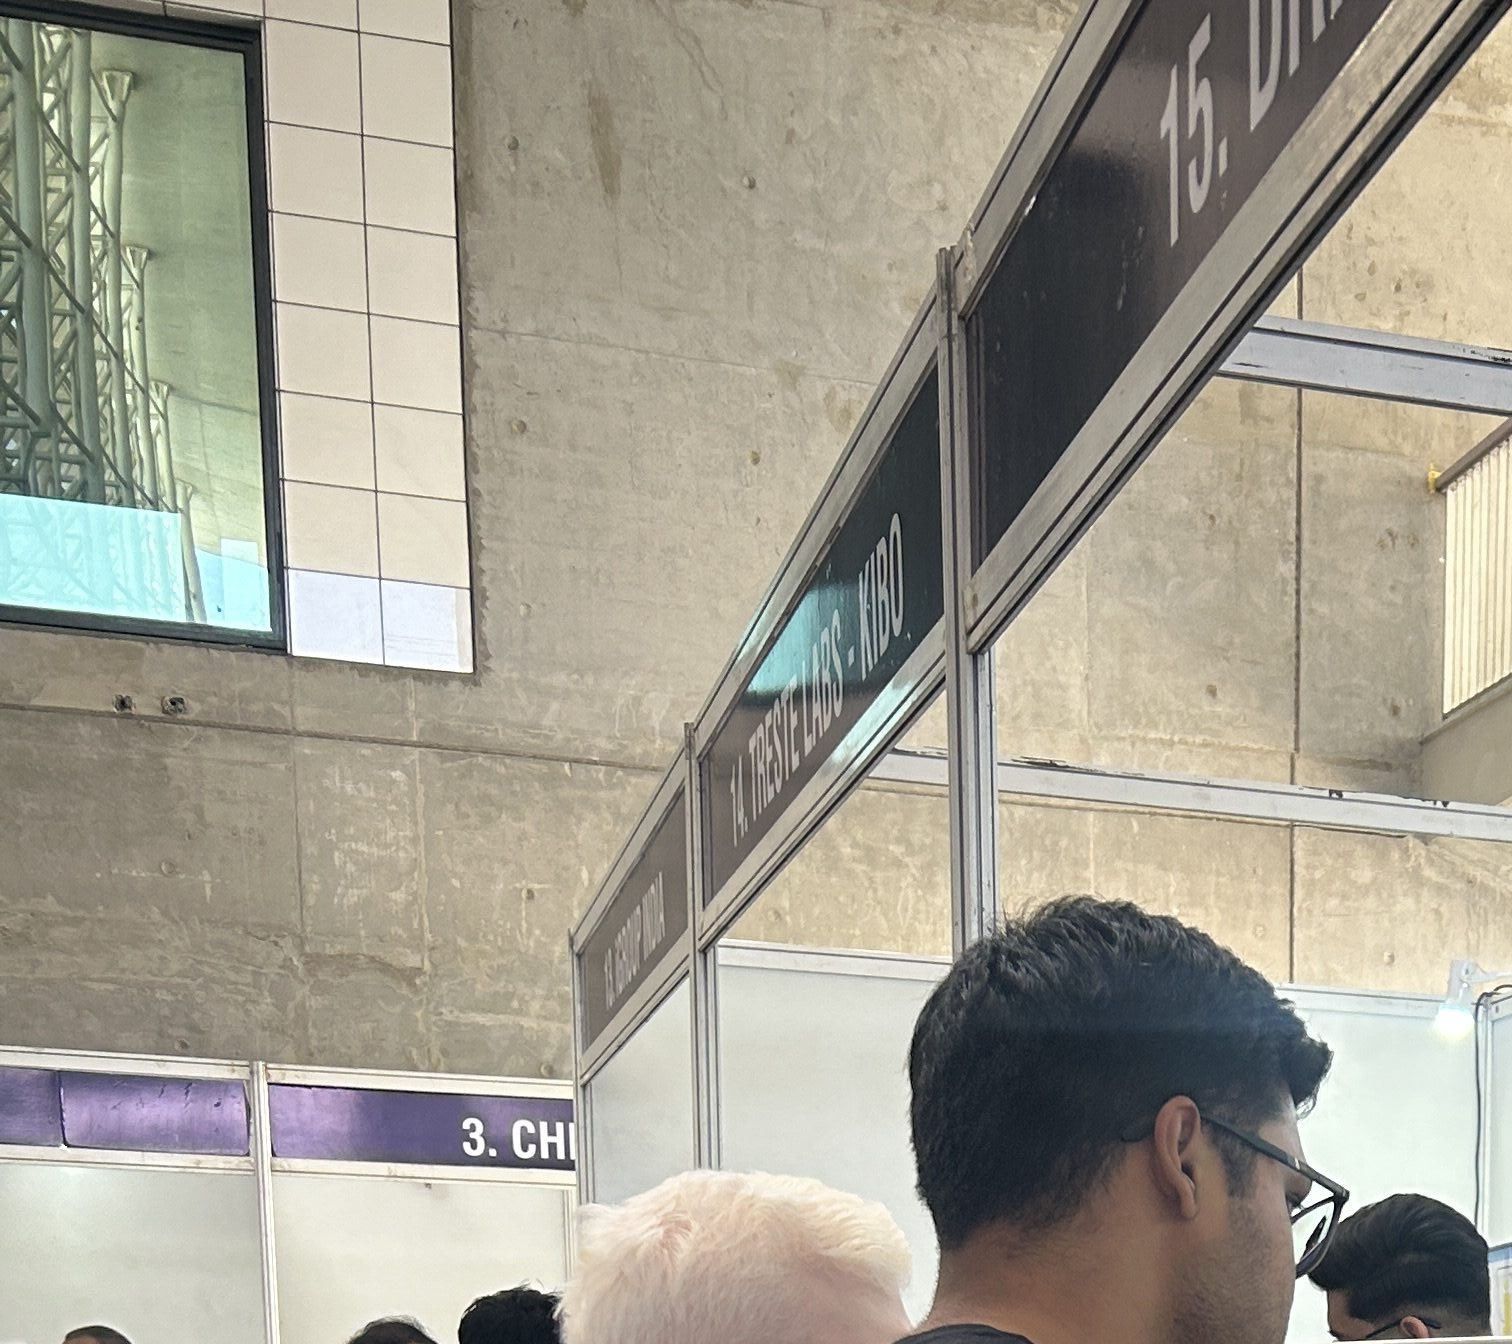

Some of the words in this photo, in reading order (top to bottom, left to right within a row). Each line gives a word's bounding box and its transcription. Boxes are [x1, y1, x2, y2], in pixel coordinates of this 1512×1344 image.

[1160, 14, 1228, 249] 15.
[729, 765, 749, 847] 14.
[749, 674, 801, 824] TRESTE
[802, 609, 845, 753] LABS
[858, 512, 905, 681] KIBO
[462, 1117, 497, 1157] 3.
